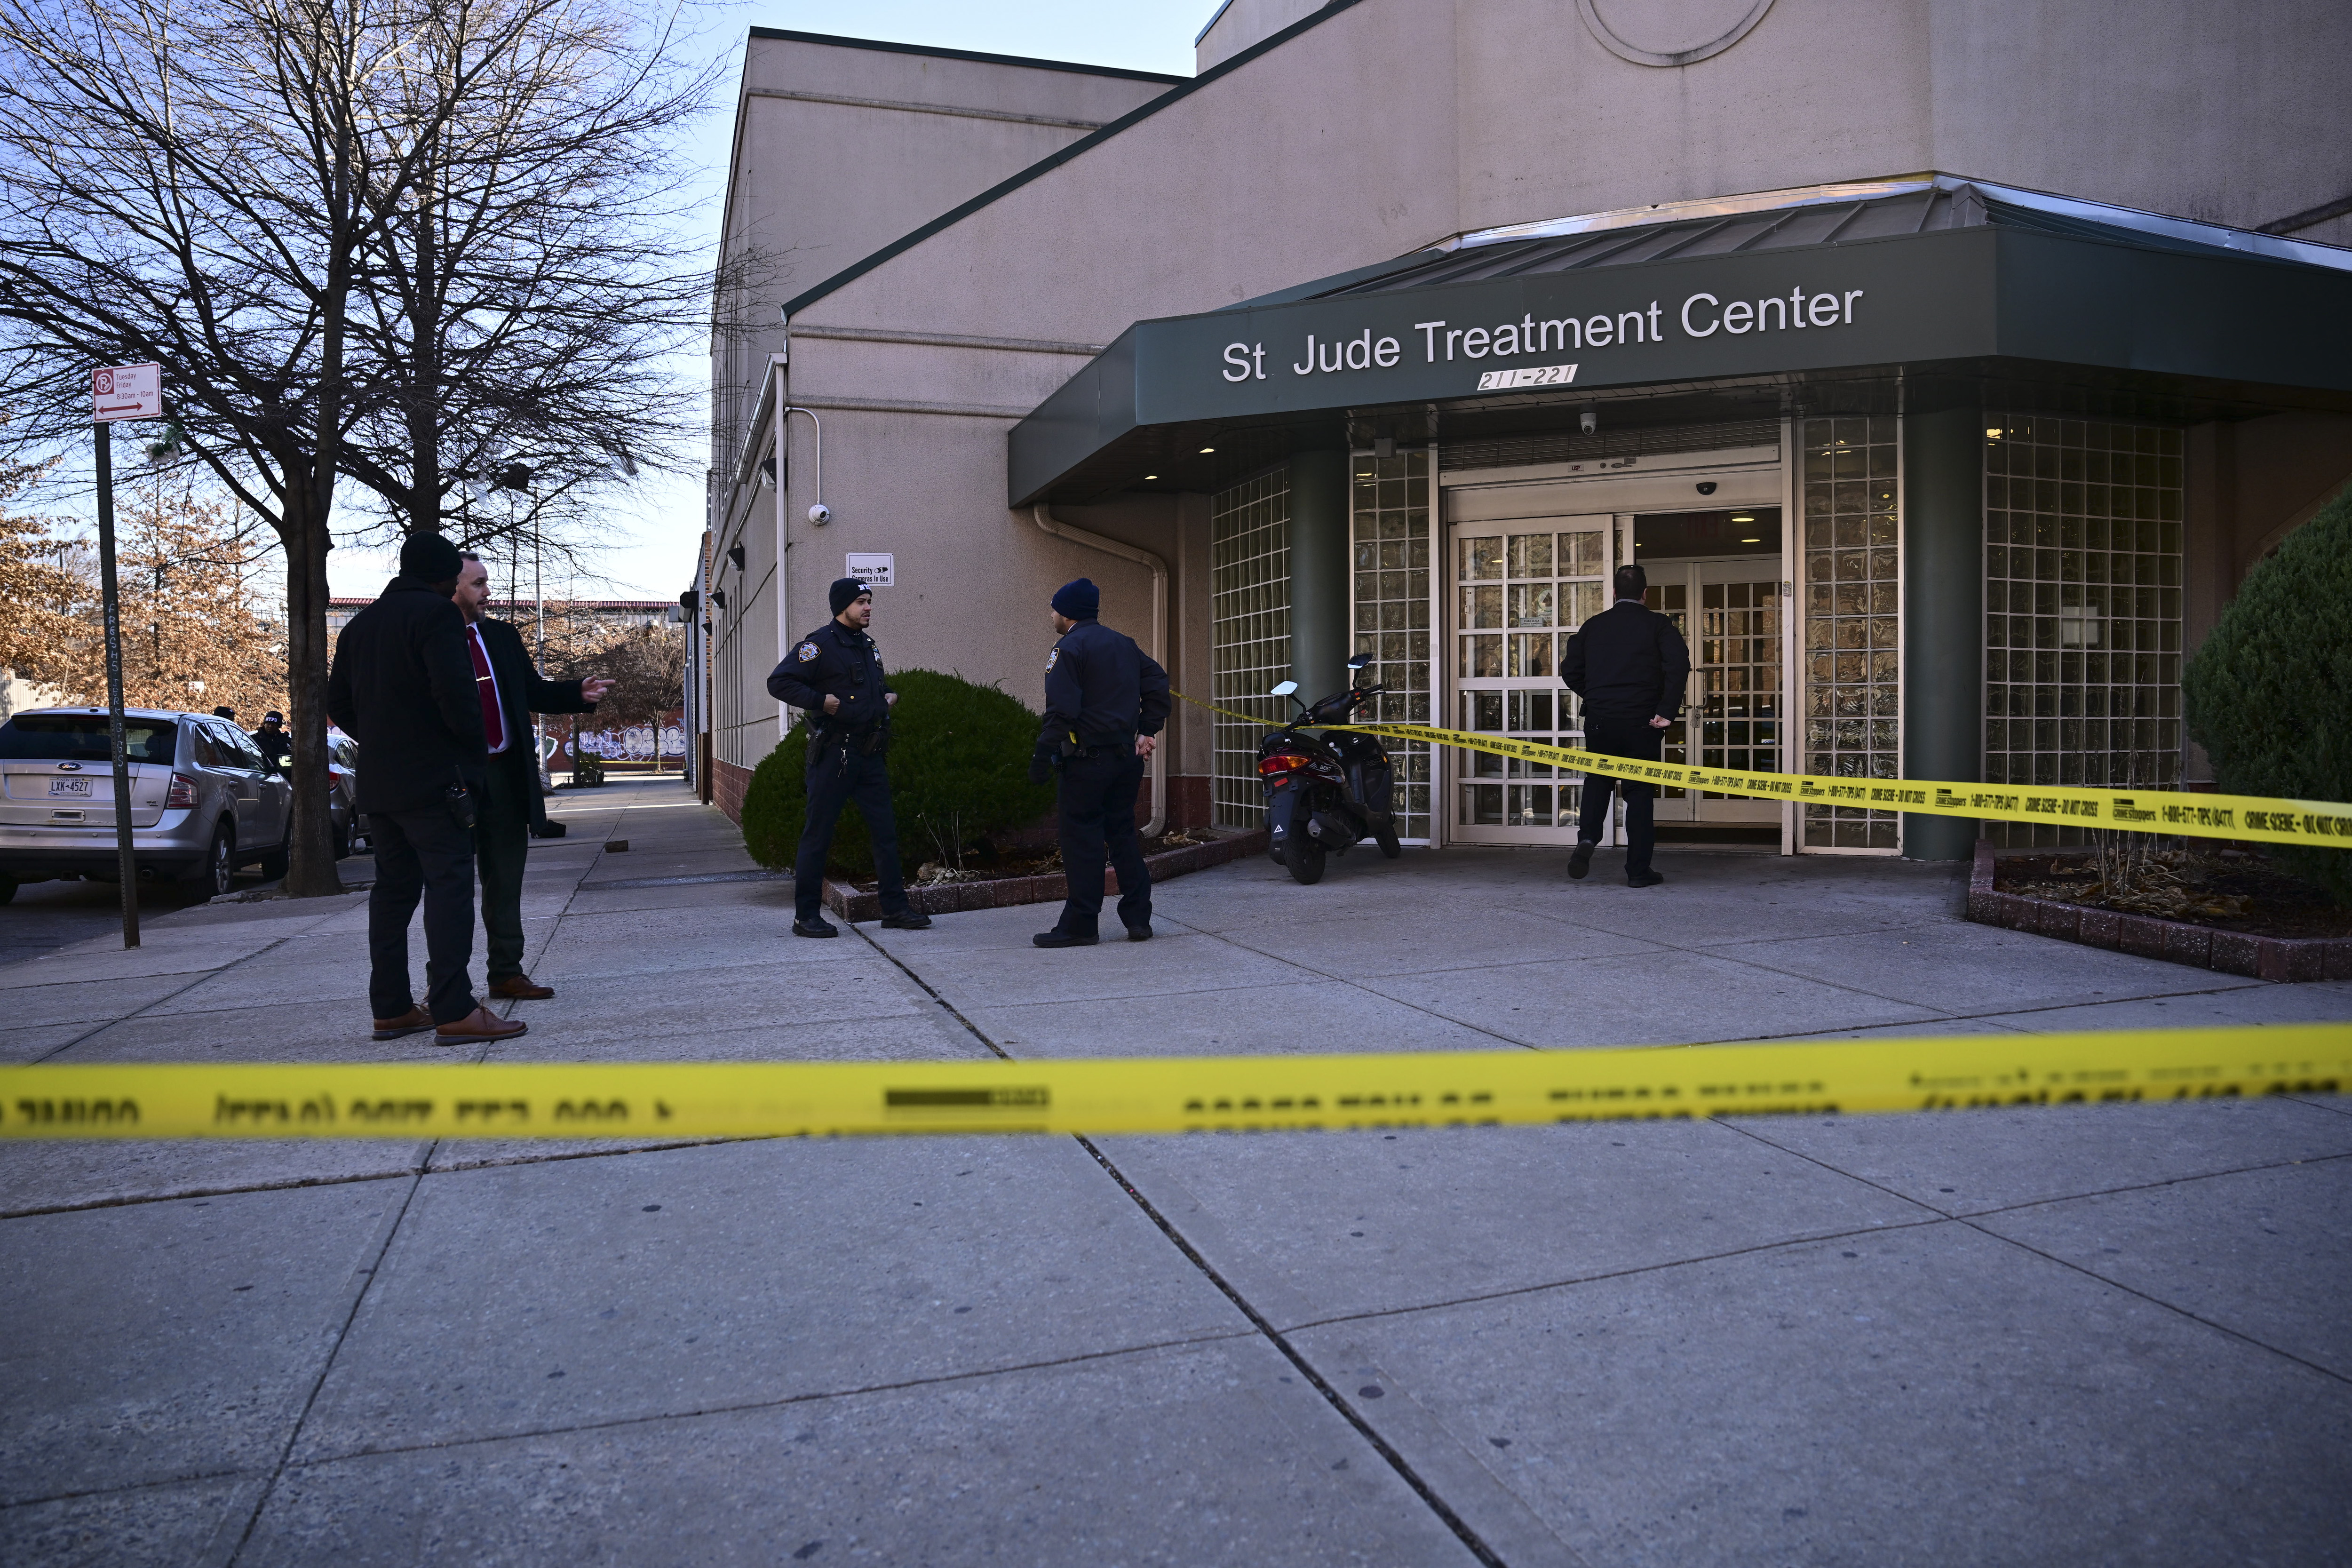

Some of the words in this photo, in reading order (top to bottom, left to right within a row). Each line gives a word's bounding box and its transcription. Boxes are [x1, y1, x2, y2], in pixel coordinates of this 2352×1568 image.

[1223, 342, 1266, 382] St
[1294, 329, 1400, 375] Jude
[1415, 301, 1663, 362] Treatment
[1682, 286, 1864, 337] Center
[1480, 366, 1572, 389] 211-221
[852, 566, 873, 575] Security
[51, 781, 65, 791] LXK
[70, 782, 88, 791] 4527
[1747, 779, 1757, 789] CRIME
[1756, 780, 1768, 791] SCENE
[1769, 781, 1775, 791] DO
[1781, 782, 1792, 794] CROSS
[1871, 788, 1882, 801] CRIME
[1883, 788, 1896, 802] SCENE
[1913, 791, 1926, 804] CROSS
